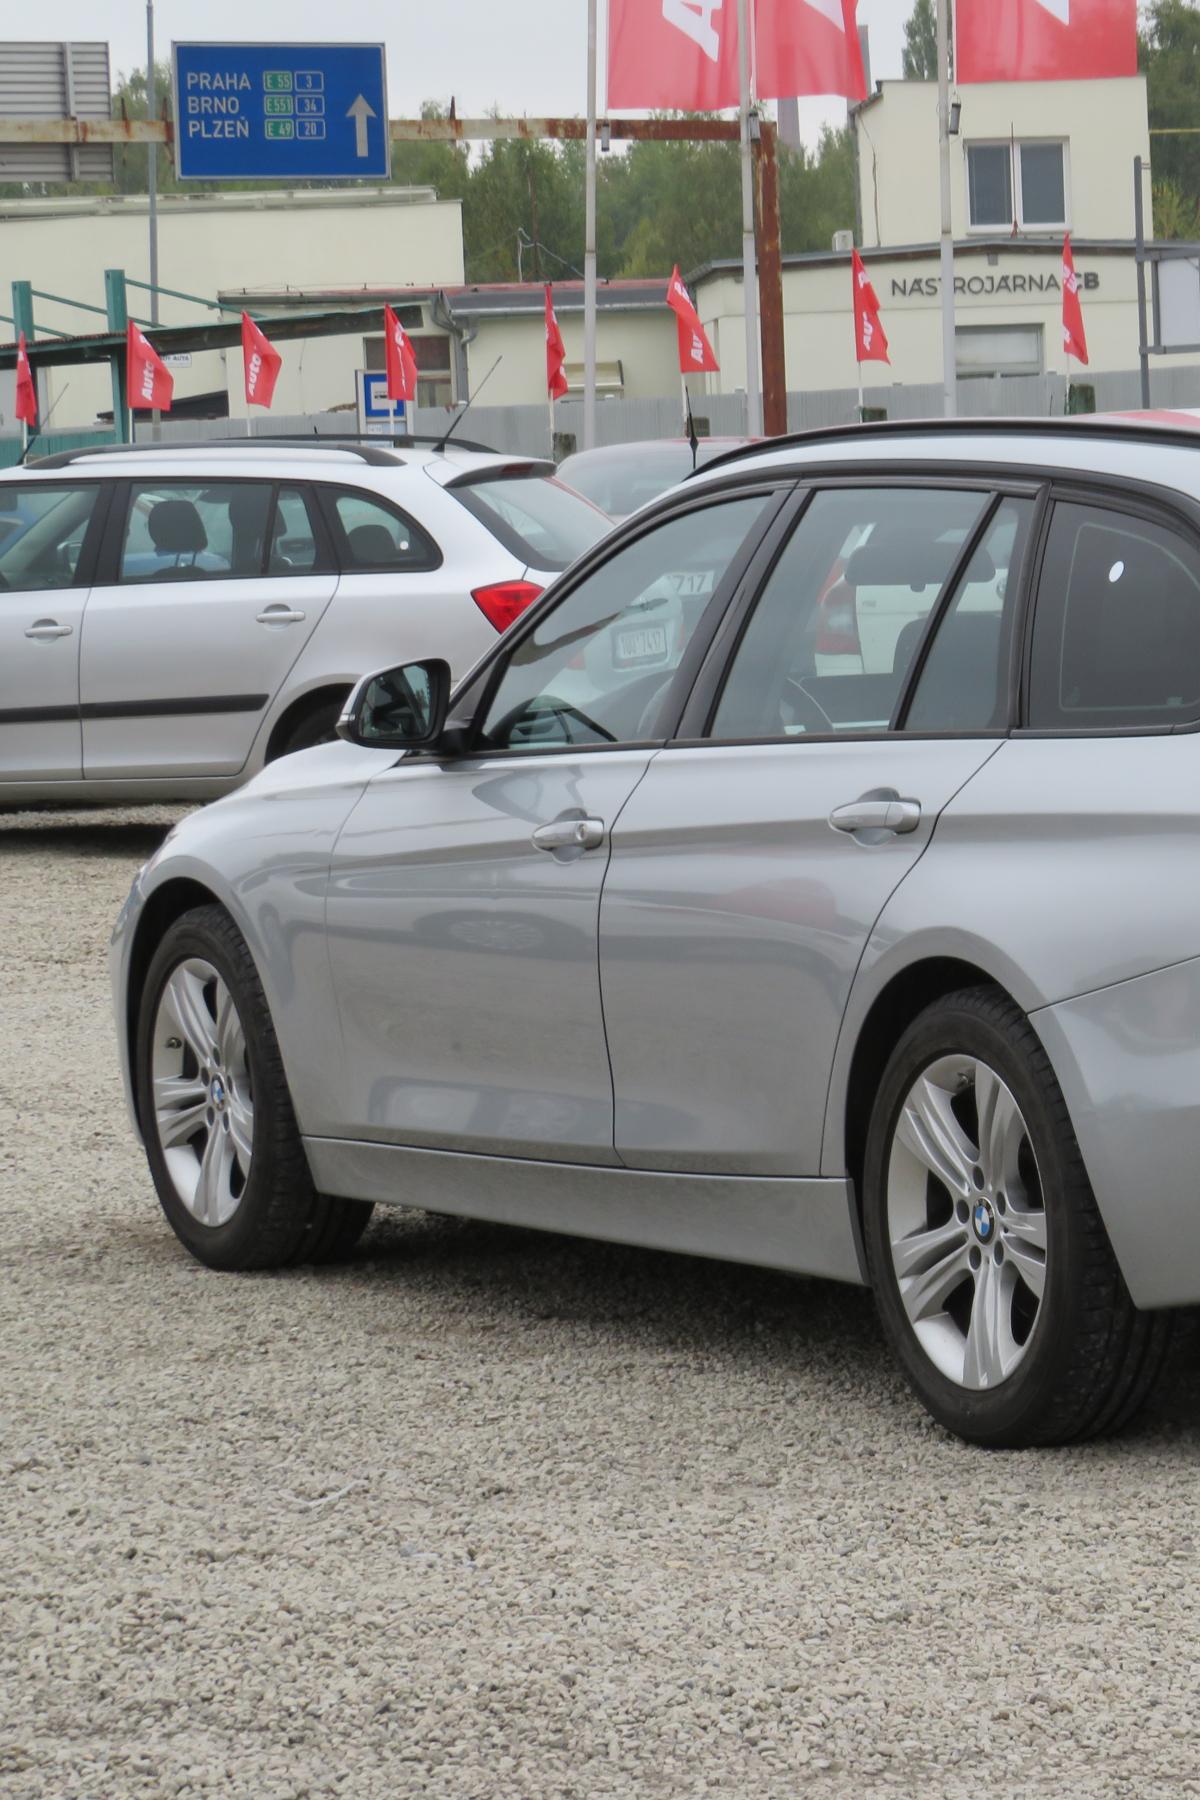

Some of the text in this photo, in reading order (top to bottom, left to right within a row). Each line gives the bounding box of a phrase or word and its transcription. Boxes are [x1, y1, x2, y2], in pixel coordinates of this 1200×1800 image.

[187, 72, 251, 90] PRAHA
[306, 75, 312, 88] 3
[188, 96, 239, 114] BRNO
[304, 98, 317, 112] 34
[189, 116, 249, 138] PLZEŇ
[305, 122, 317, 135] 20
[891, 273, 1061, 296] NÁSROJÁRNA
[248, 353, 262, 397] Auto
